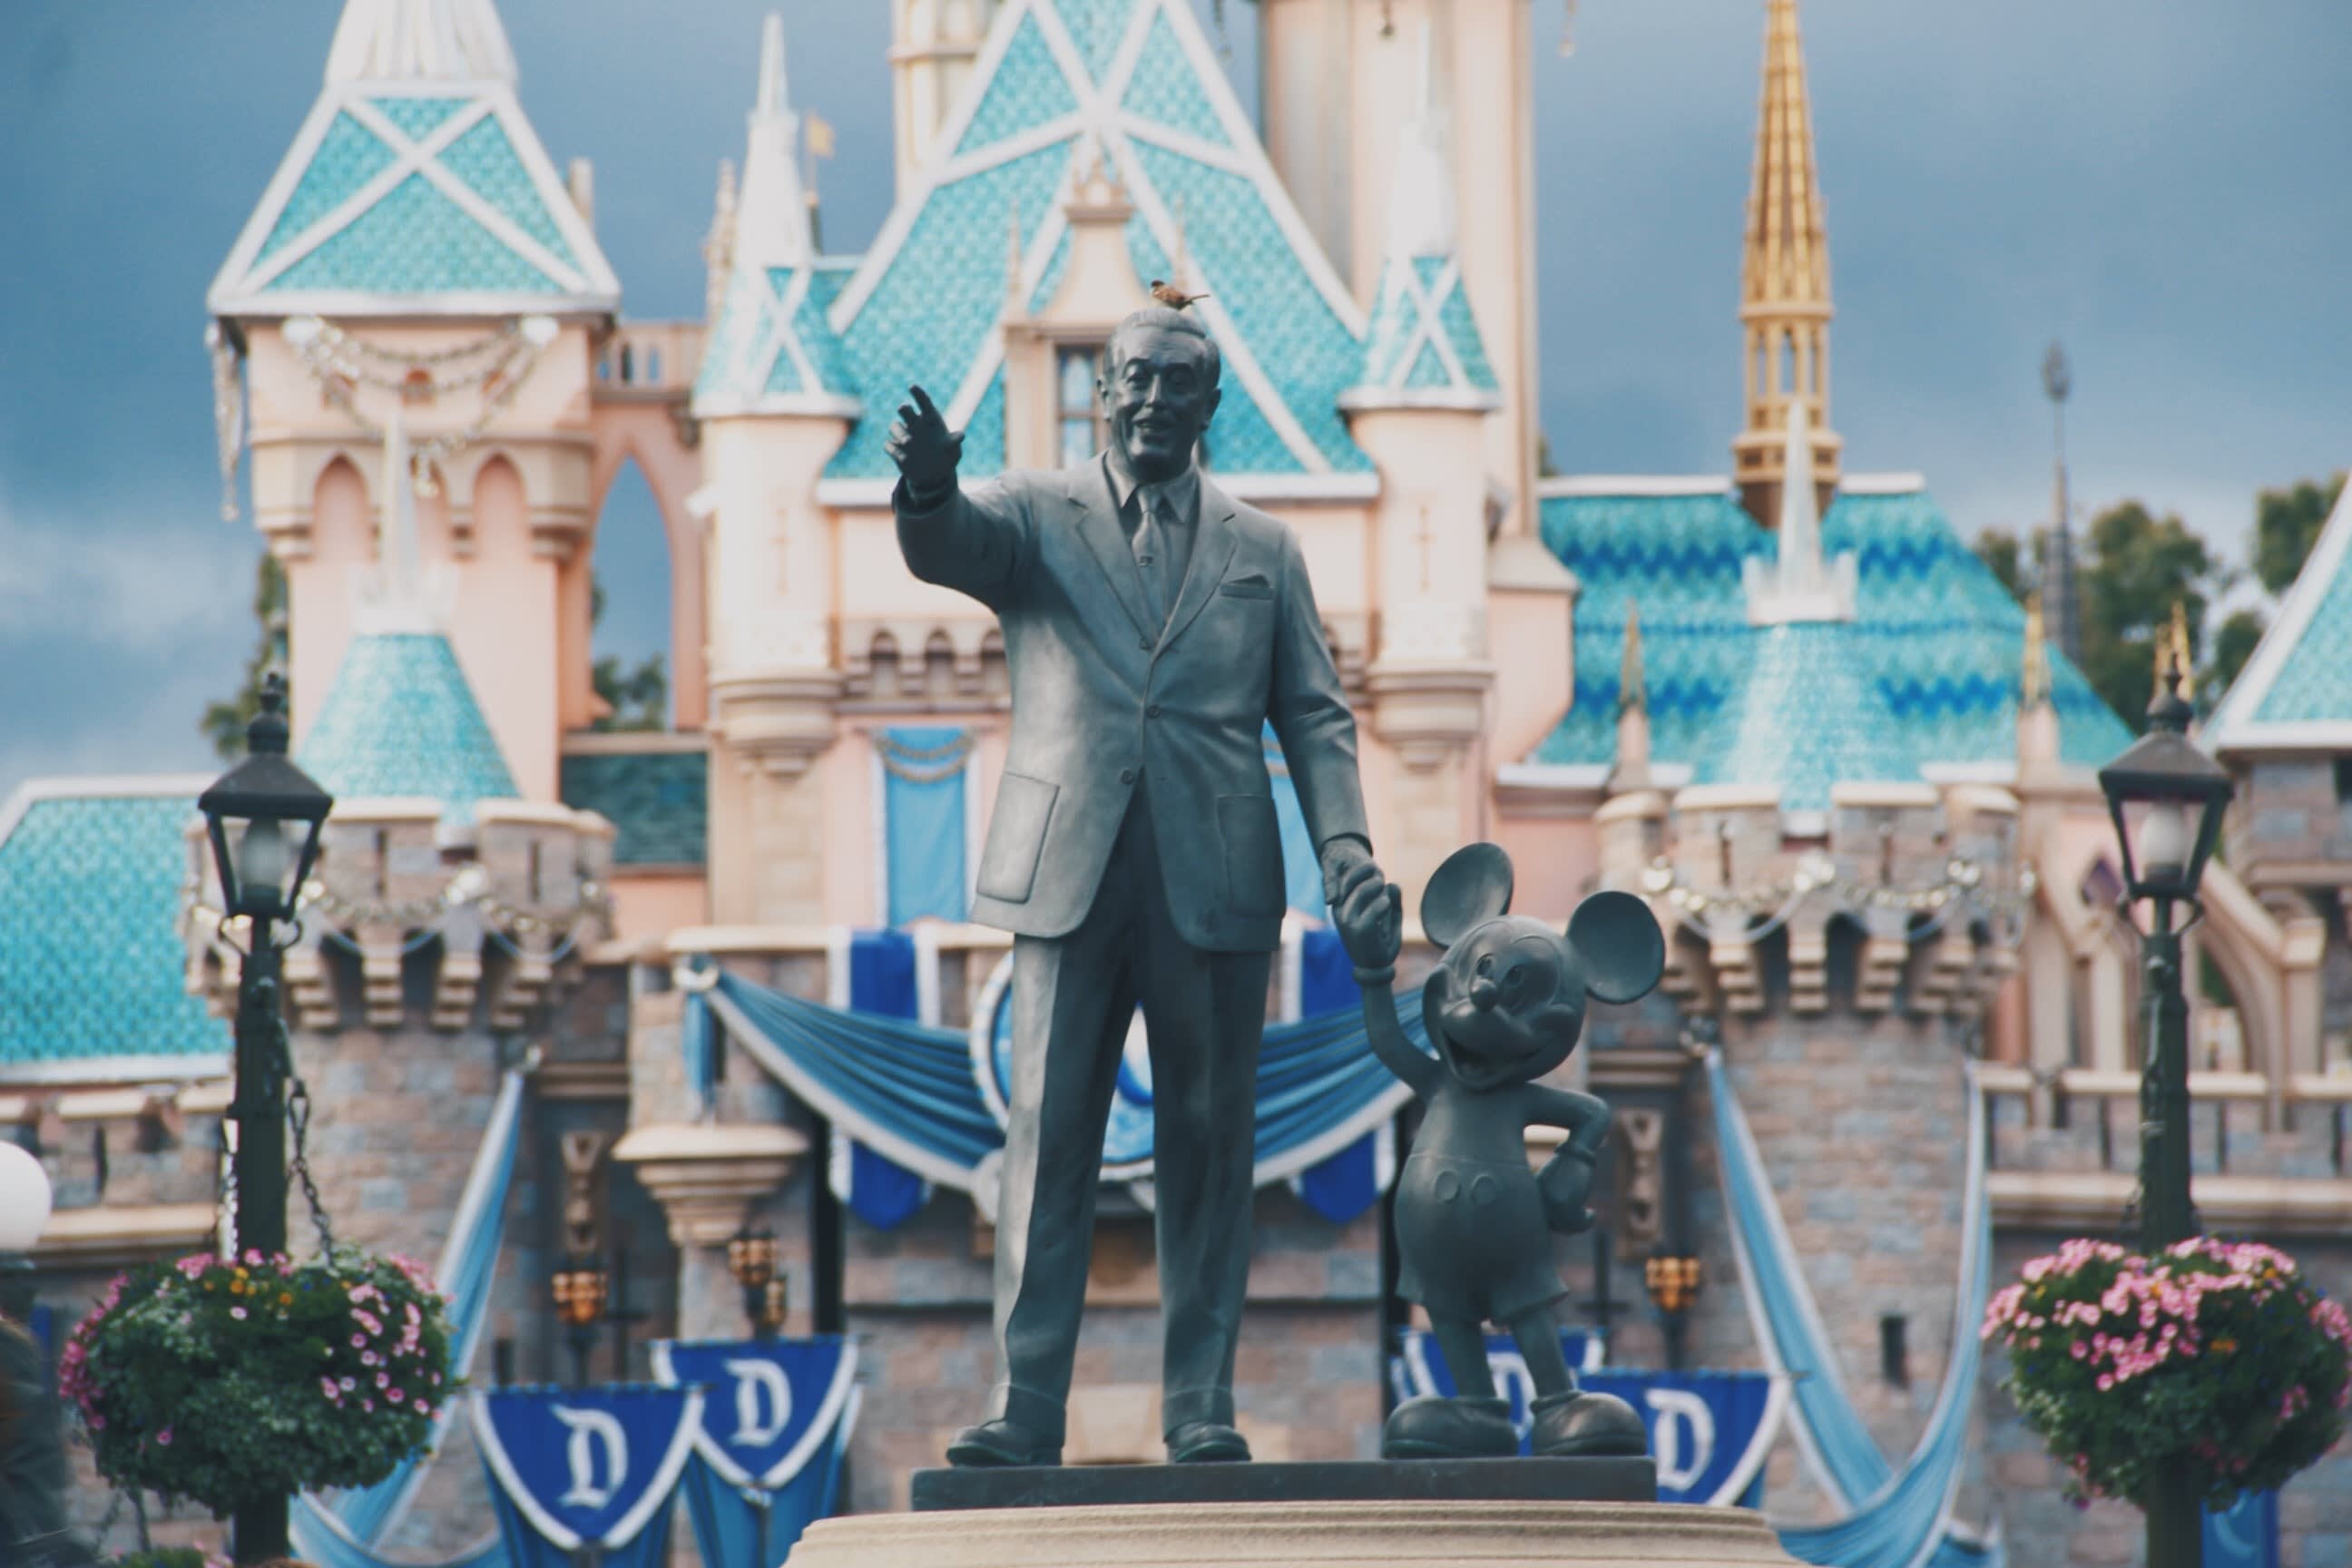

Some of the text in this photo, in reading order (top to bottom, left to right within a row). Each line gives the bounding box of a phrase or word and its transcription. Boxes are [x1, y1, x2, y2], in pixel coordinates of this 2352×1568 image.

[723, 1358, 791, 1446] D
[1645, 1388, 1714, 1492] D
[549, 1404, 628, 1509] D
